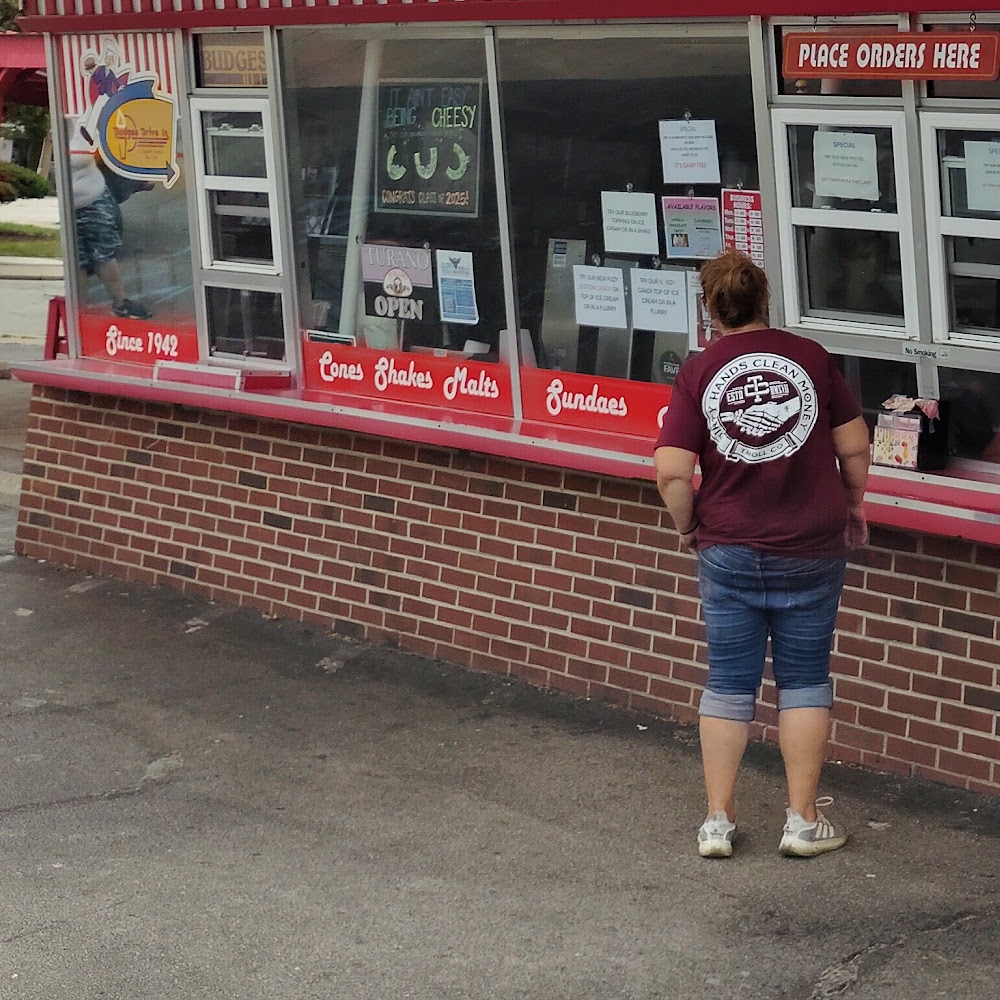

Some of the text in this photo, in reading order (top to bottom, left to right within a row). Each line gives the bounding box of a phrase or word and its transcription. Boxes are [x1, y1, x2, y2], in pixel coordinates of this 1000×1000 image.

[798, 43, 981, 69] PLACE ORDERS HERE
[387, 105, 477, 129] BEING CHEESY
[832, 141, 857, 149] SPECIAL
[382, 189, 415, 205] CONGRATS
[446, 191, 469, 205] 2025!
[694, 203, 717, 211] FLAVORS
[365, 247, 429, 270] TURANO
[374, 295, 423, 320] OPEN
[105, 324, 178, 357] Since 1942
[905, 347, 937, 359] No Smoking
[318, 350, 628, 416] Cones Shakes Malts Sundaes
[709, 360, 748, 401] HANDS
[752, 359, 799, 379] CLEAN
[798, 380, 813, 432] MONEY
[740, 443, 784, 458] TROLL CO
